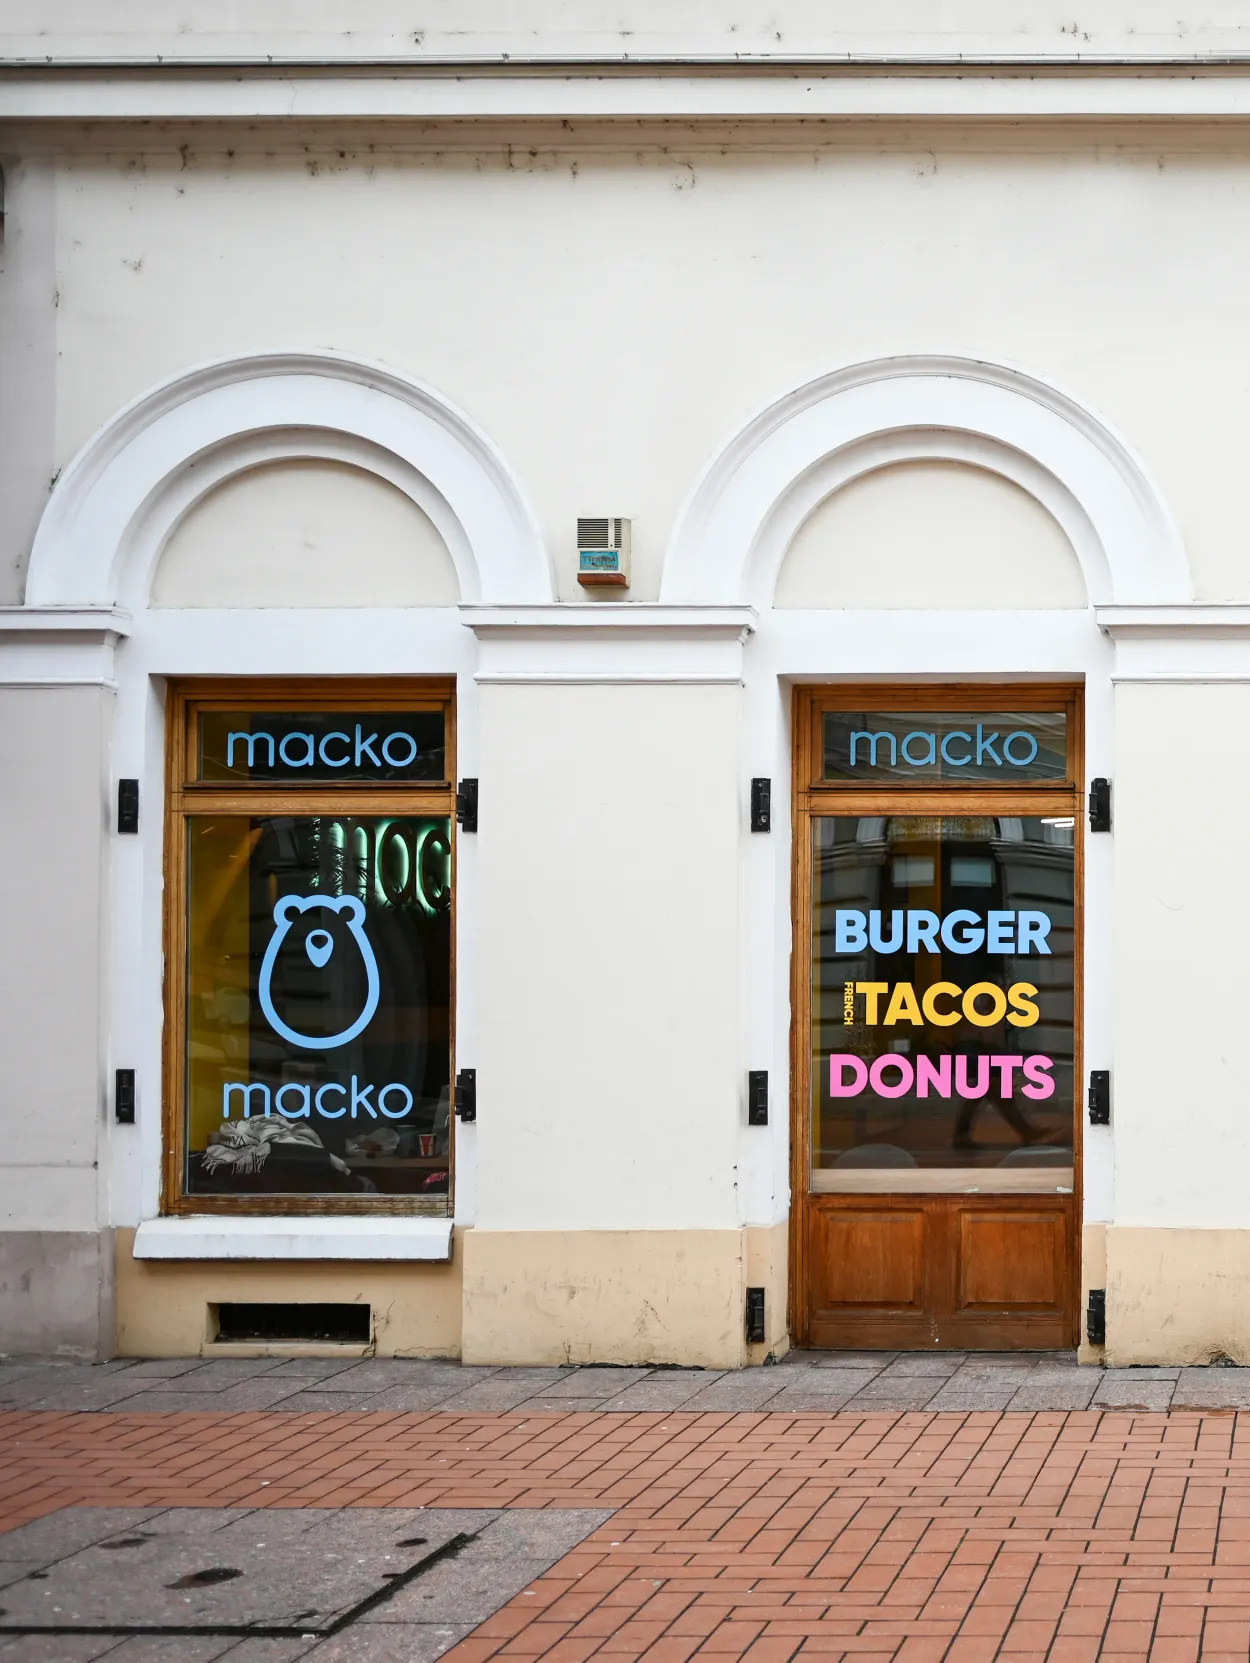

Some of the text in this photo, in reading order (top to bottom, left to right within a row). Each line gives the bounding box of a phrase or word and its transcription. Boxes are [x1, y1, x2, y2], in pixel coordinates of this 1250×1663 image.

[227, 723, 417, 768] macko
[849, 723, 1038, 767] macko
[835, 910, 1052, 955] BURGER
[843, 981, 854, 1026] FRENCH
[856, 981, 1040, 1028] TACOS
[223, 1074, 414, 1119] macko
[829, 1053, 1055, 1100] DONUTS
